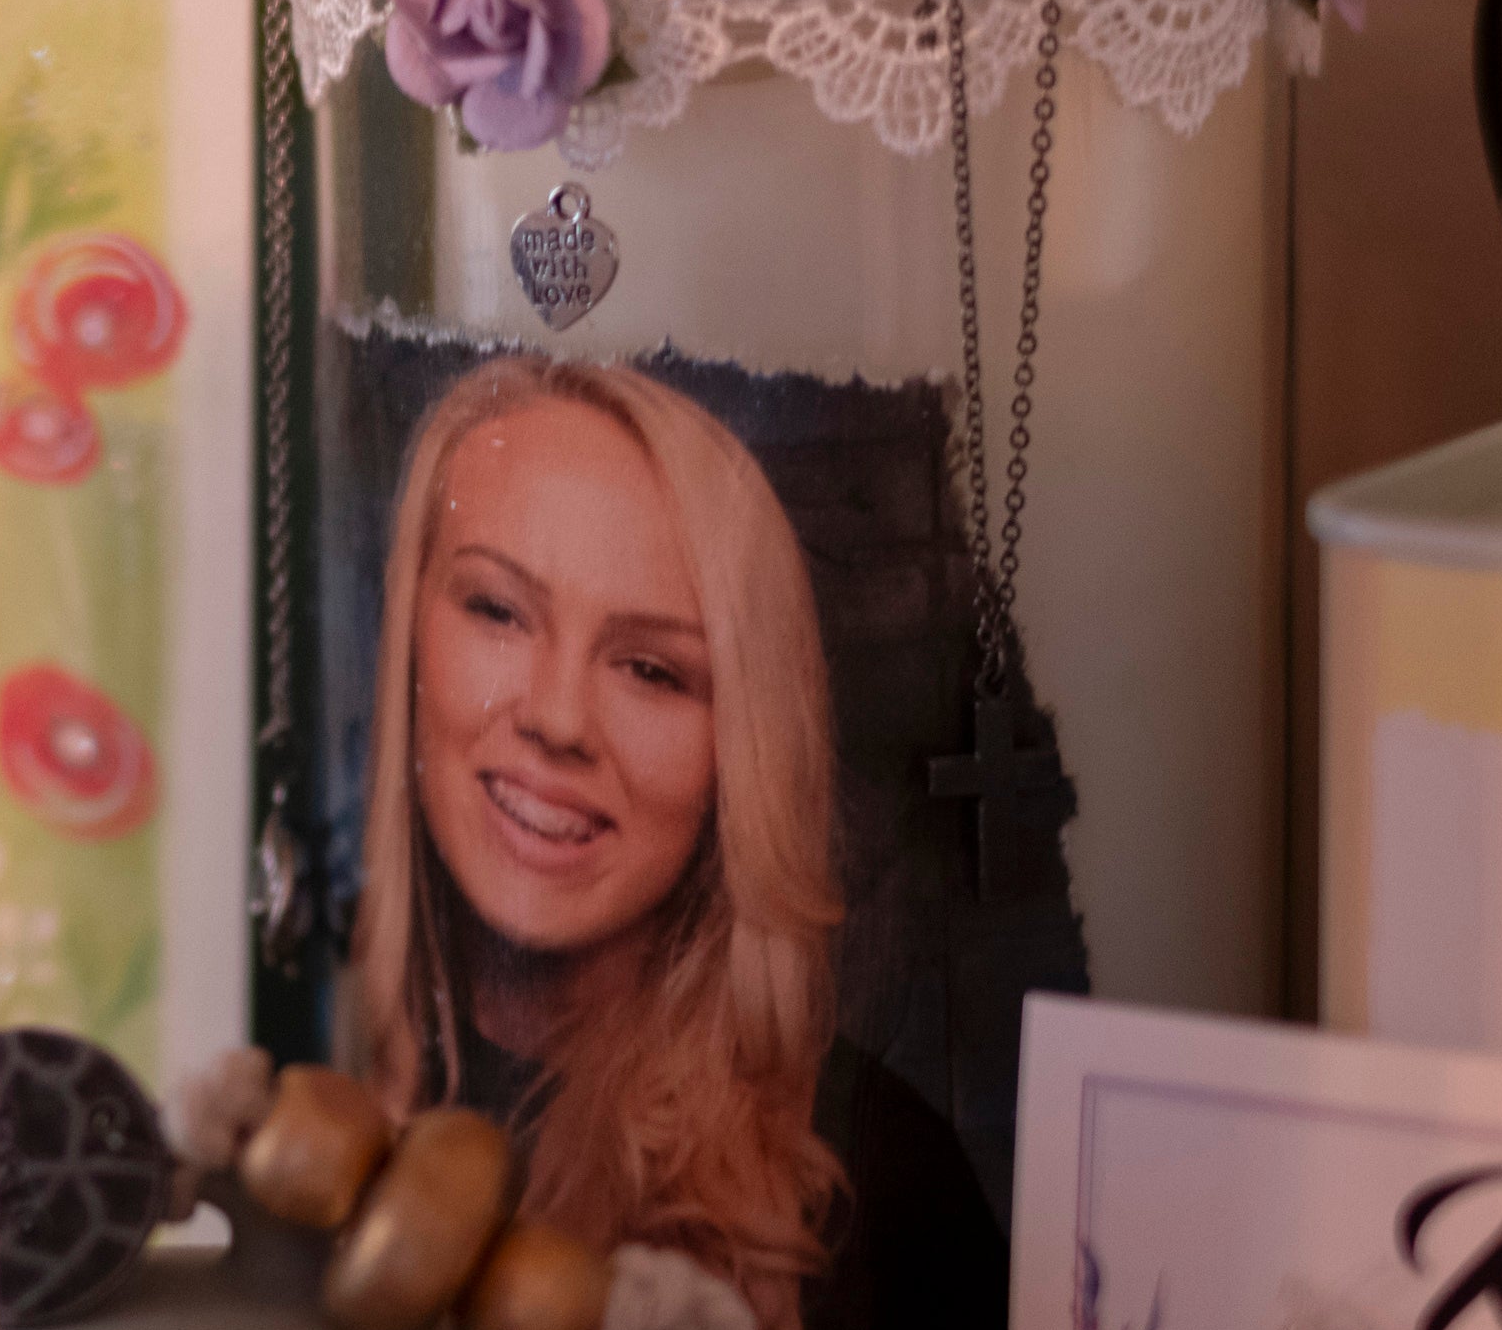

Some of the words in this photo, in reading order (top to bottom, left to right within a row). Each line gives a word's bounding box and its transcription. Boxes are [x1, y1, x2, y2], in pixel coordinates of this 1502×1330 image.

[522, 222, 595, 252] made
[531, 254, 588, 280] with
[533, 281, 592, 306] love
